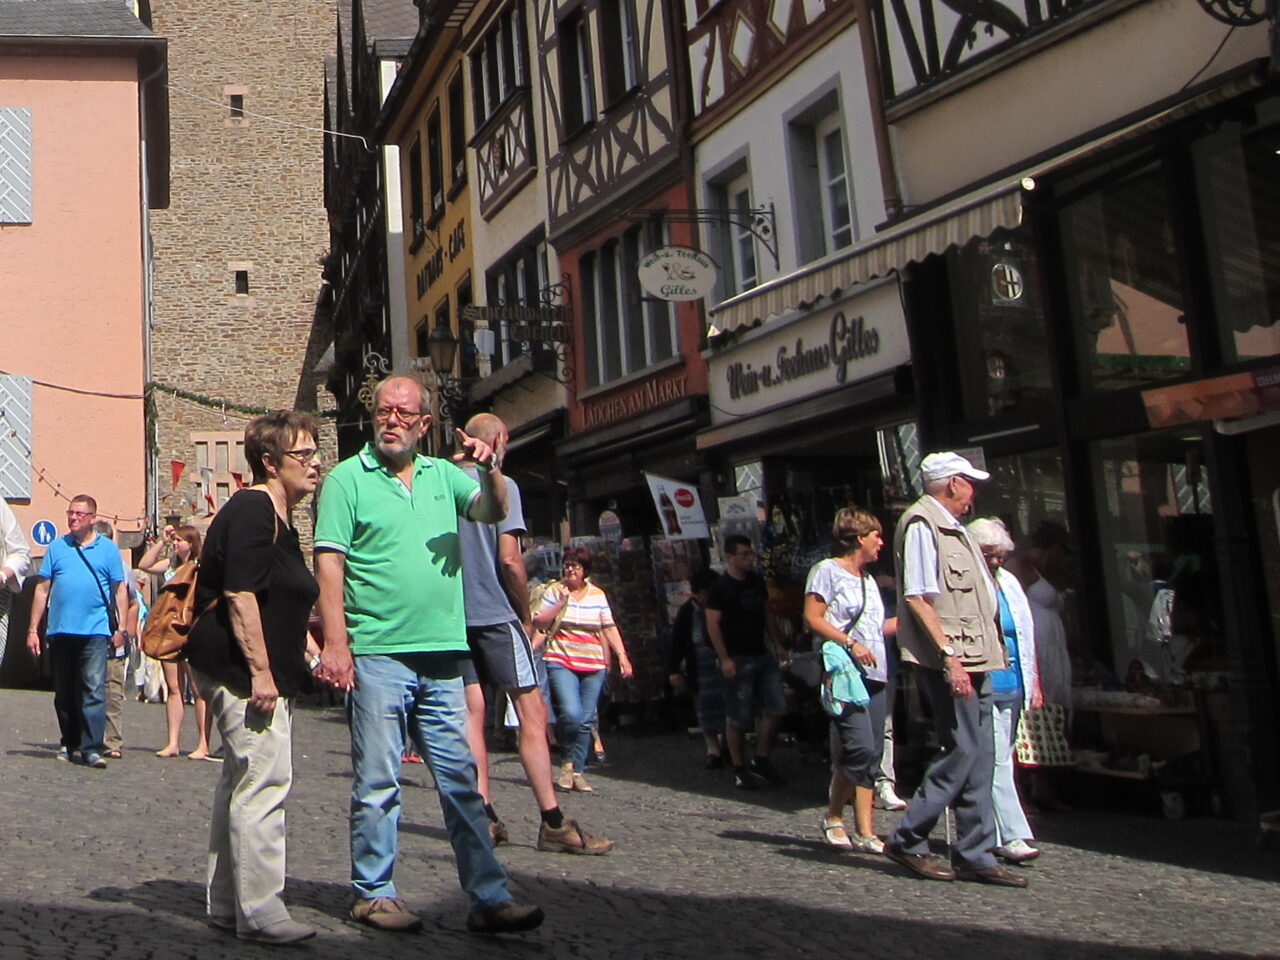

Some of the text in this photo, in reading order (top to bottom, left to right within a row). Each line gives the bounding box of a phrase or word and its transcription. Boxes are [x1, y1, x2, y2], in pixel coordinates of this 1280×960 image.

[660, 284, 698, 298] Gilles
[830, 310, 880, 384] Gilles
[645, 376, 688, 407] MARKT
